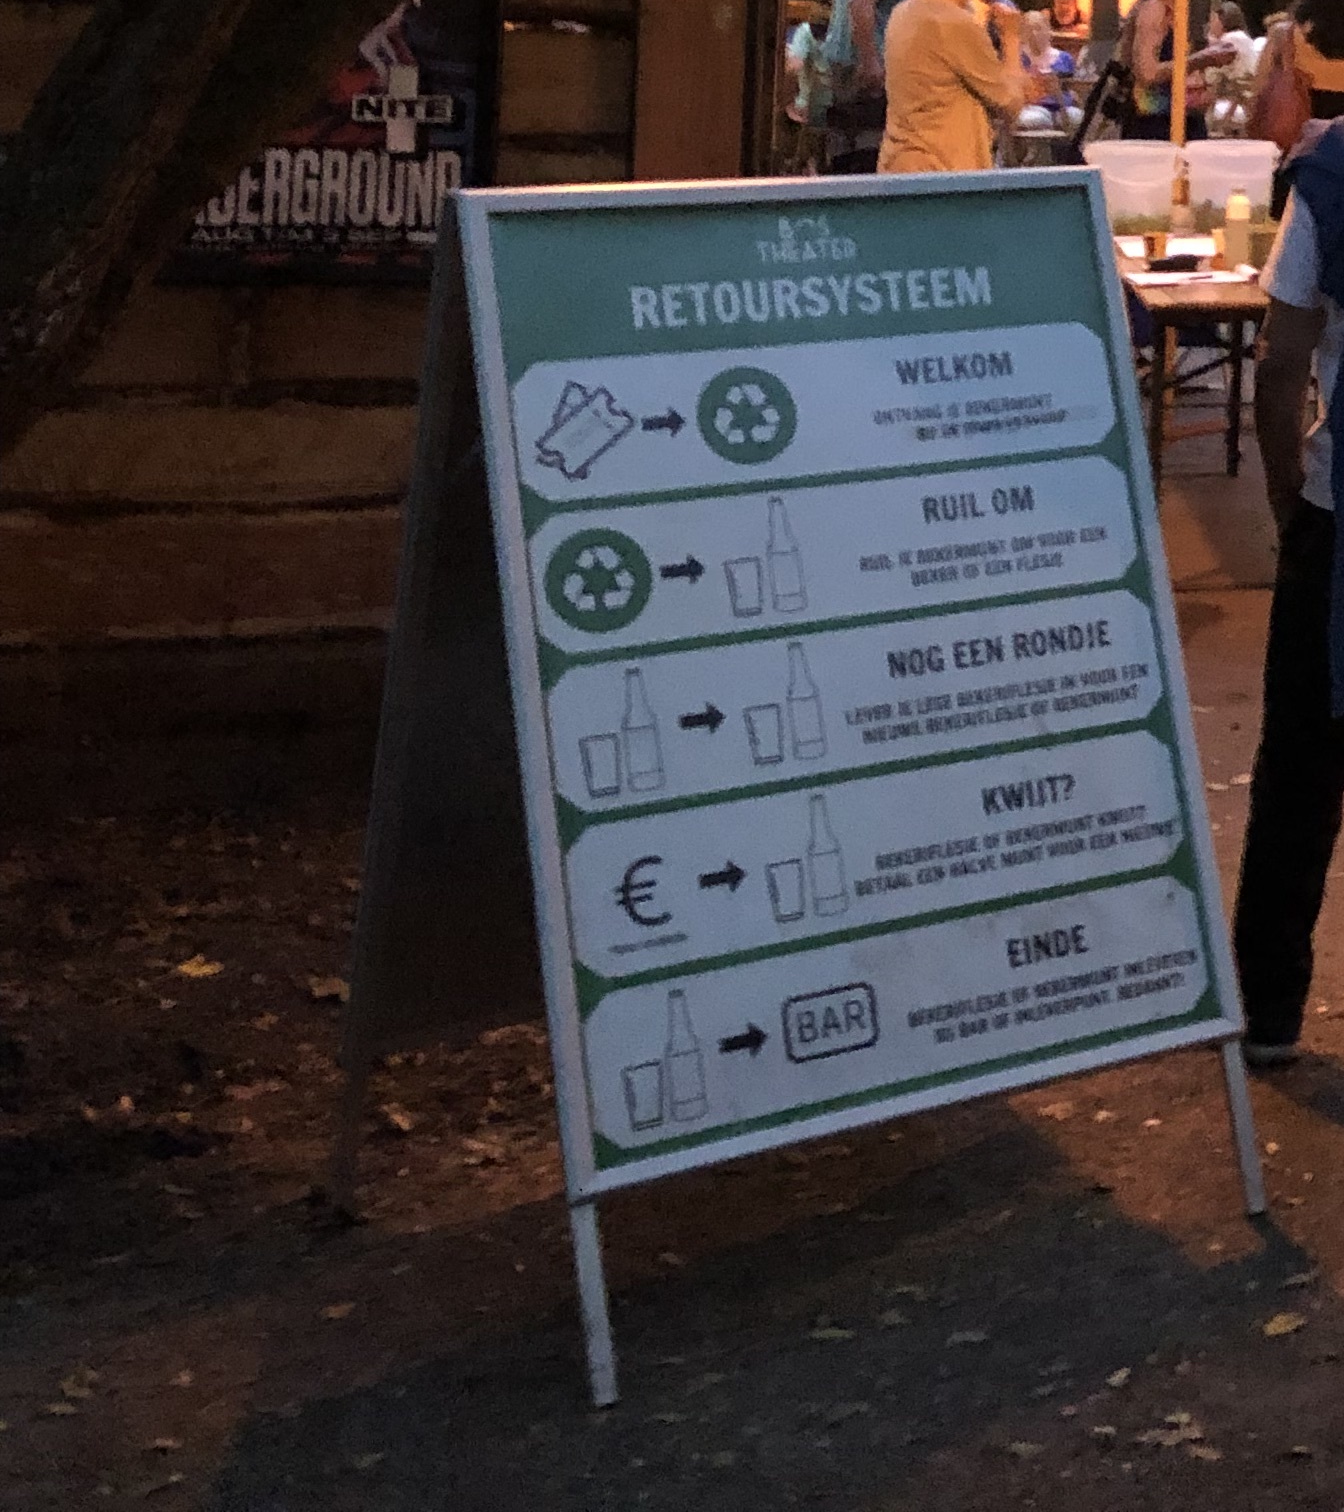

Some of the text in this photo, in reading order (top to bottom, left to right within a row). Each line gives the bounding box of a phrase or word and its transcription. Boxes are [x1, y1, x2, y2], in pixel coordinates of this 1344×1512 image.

[630, 266, 993, 330] RETOURSYSTEEM
[895, 351, 1014, 385] WELKOM
[921, 484, 1036, 525] RUIL OM
[886, 619, 1112, 679] NOG EEN RONDJE
[981, 773, 1076, 816] KWIJT?
[1007, 923, 1090, 969] EINDE
[796, 998, 866, 1044] BAR
